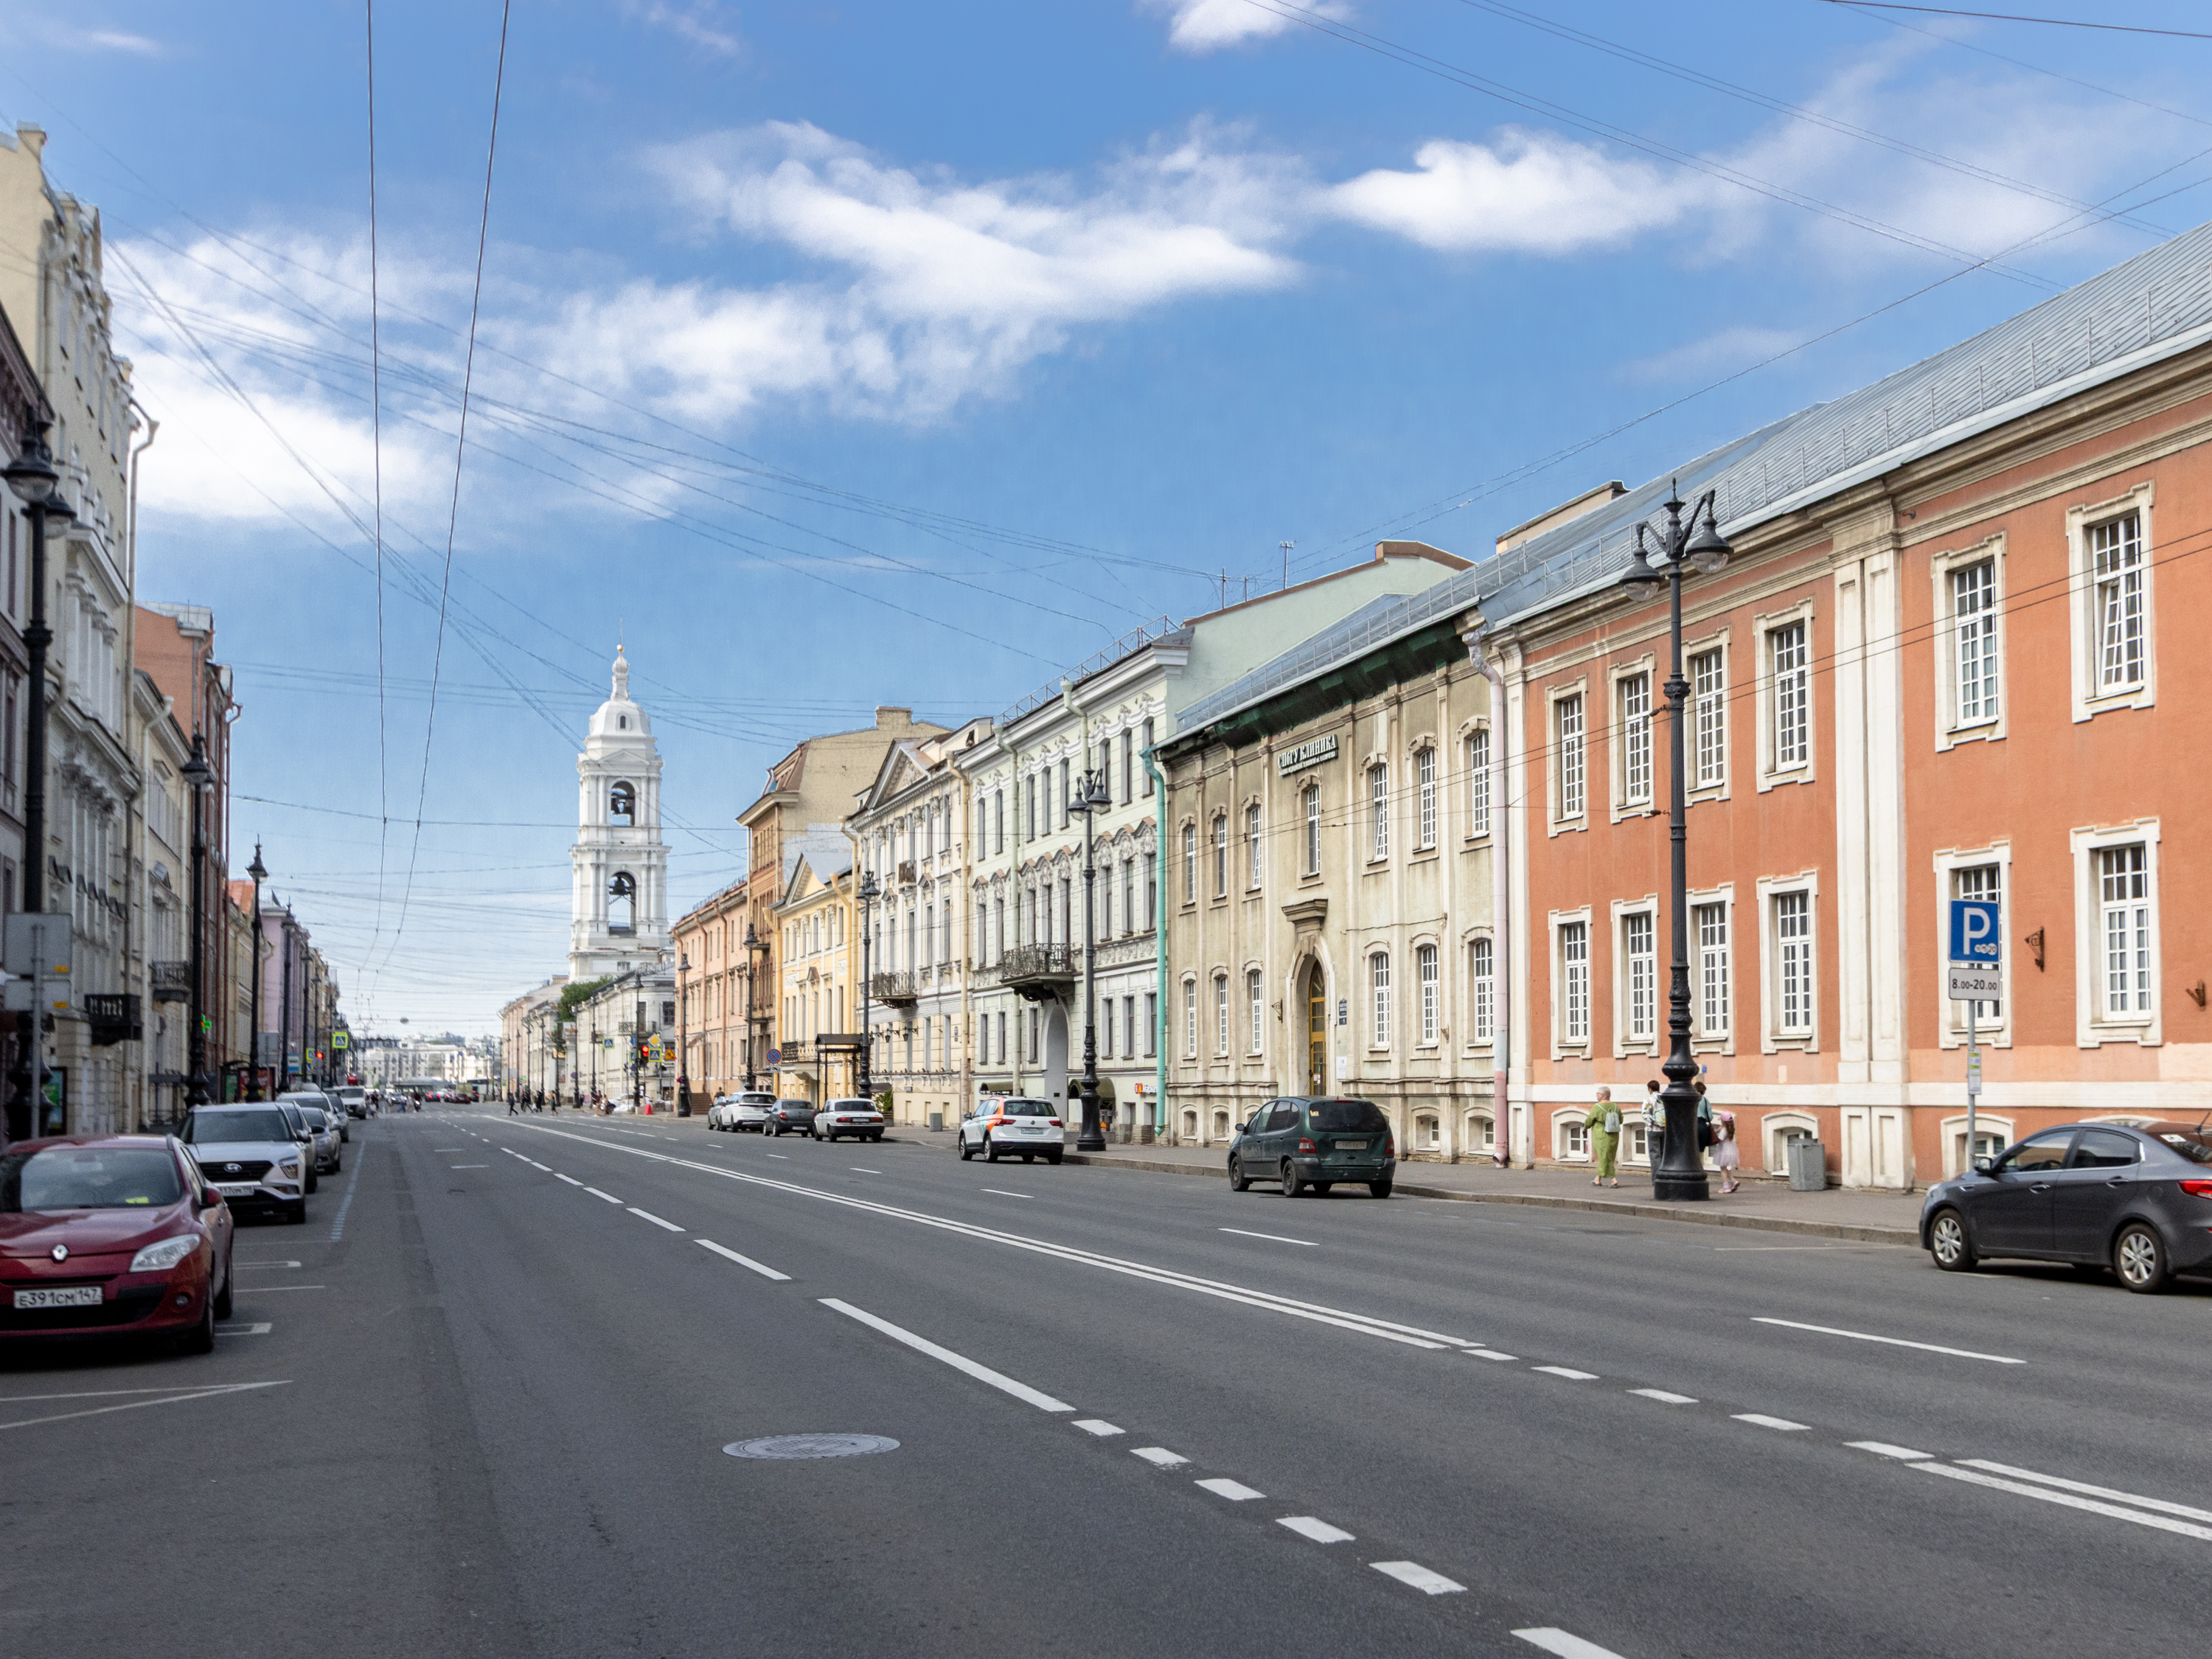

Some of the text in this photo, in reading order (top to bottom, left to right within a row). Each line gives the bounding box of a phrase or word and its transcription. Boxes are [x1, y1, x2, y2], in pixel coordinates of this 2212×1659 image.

[1300, 734, 1335, 761] КЛИНИКА
[1952, 978, 1997, 991] 8.00-20.00
[19, 1289, 97, 1306] Е391СМ 147
